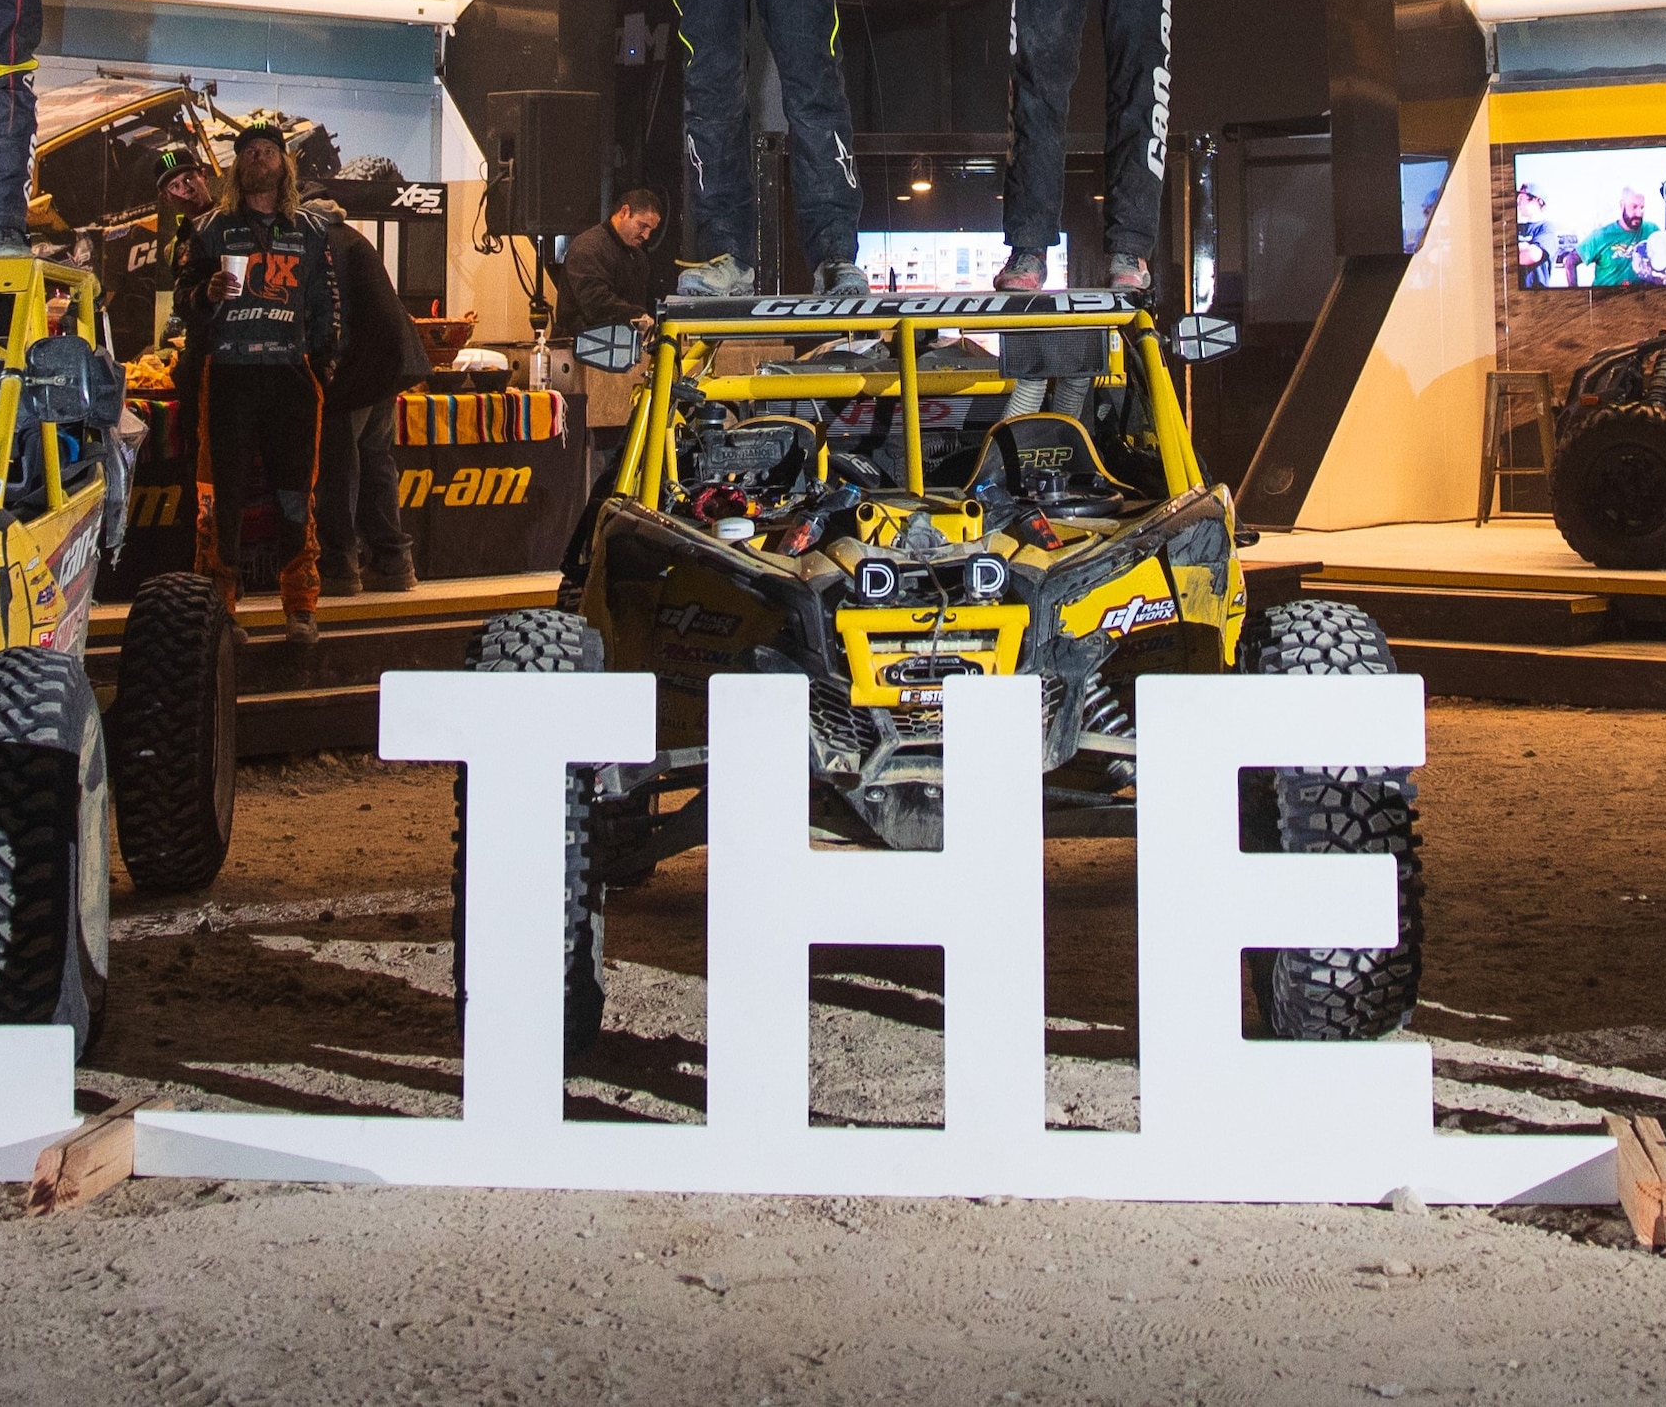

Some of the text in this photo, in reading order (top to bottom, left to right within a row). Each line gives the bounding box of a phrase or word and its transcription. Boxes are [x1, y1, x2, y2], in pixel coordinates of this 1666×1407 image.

[391, 183, 443, 207] XPS
[226, 307, 295, 323] can-am
[750, 292, 1011, 317] can-am
[1019, 446, 1074, 469] PRP
[397, 464, 532, 508] n-am
[1136, 607, 1175, 623] WORX
[1140, 598, 1175, 614] RACE
[378, 670, 1436, 1139] THE
